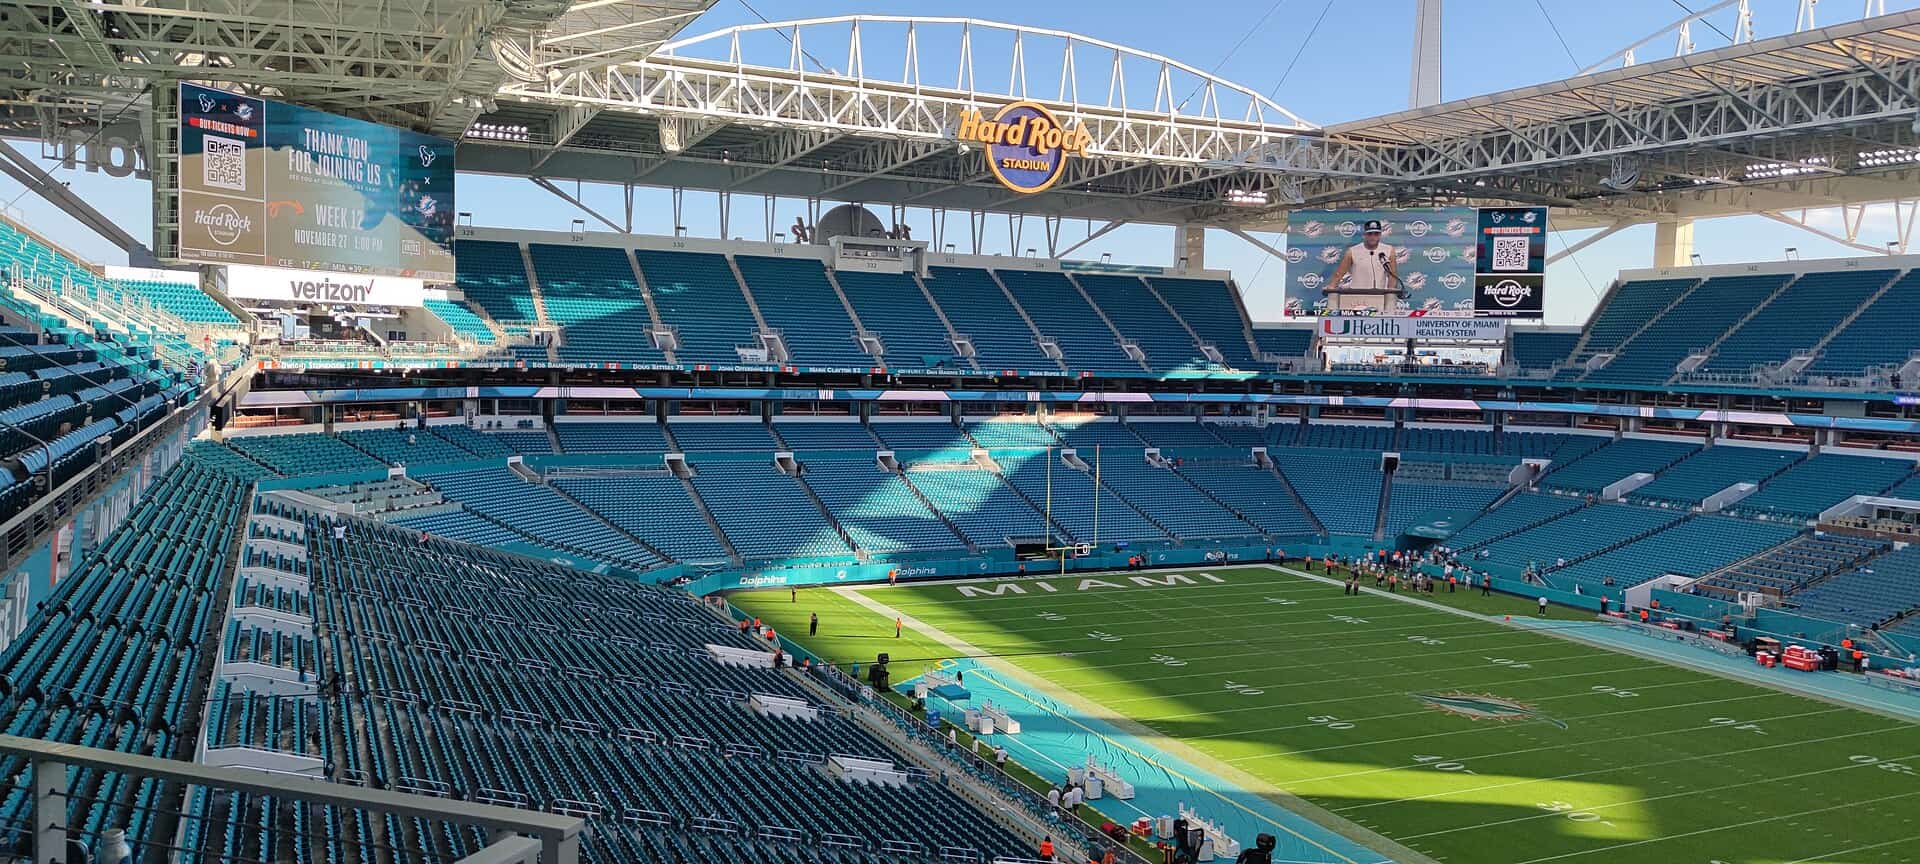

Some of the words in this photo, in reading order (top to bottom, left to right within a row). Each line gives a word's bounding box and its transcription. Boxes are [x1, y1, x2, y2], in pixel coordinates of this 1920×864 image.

[957, 110, 1028, 145] Hard
[1028, 117, 1091, 157] Rock
[304, 128, 343, 157] THANK
[347, 137, 368, 160] YOU
[288, 149, 311, 173] FOR
[315, 154, 363, 182] JOINING
[367, 163, 381, 185] US
[1003, 158, 1050, 171] STADIUM
[194, 210, 223, 226] Hard
[225, 214, 251, 232] Rock
[315, 203, 347, 229] WEEK
[351, 209, 363, 231] 12
[294, 229, 336, 247] NOVEMBER
[290, 278, 365, 301] verizon
[1484, 285, 1508, 295] Hard
[1508, 285, 1531, 297] Rock
[1416, 320, 1460, 328] UNIVERSITY
[1474, 321, 1500, 329] MIAMI
[1447, 329, 1477, 337] SYSTEM
[739, 575, 787, 586] Dolphins
[894, 566, 936, 577] Dolphins
[956, 573, 1225, 597] MIAMI
[1307, 715, 1355, 729] 50
[1412, 755, 1465, 770] 40
[1536, 800, 1601, 821] 30
